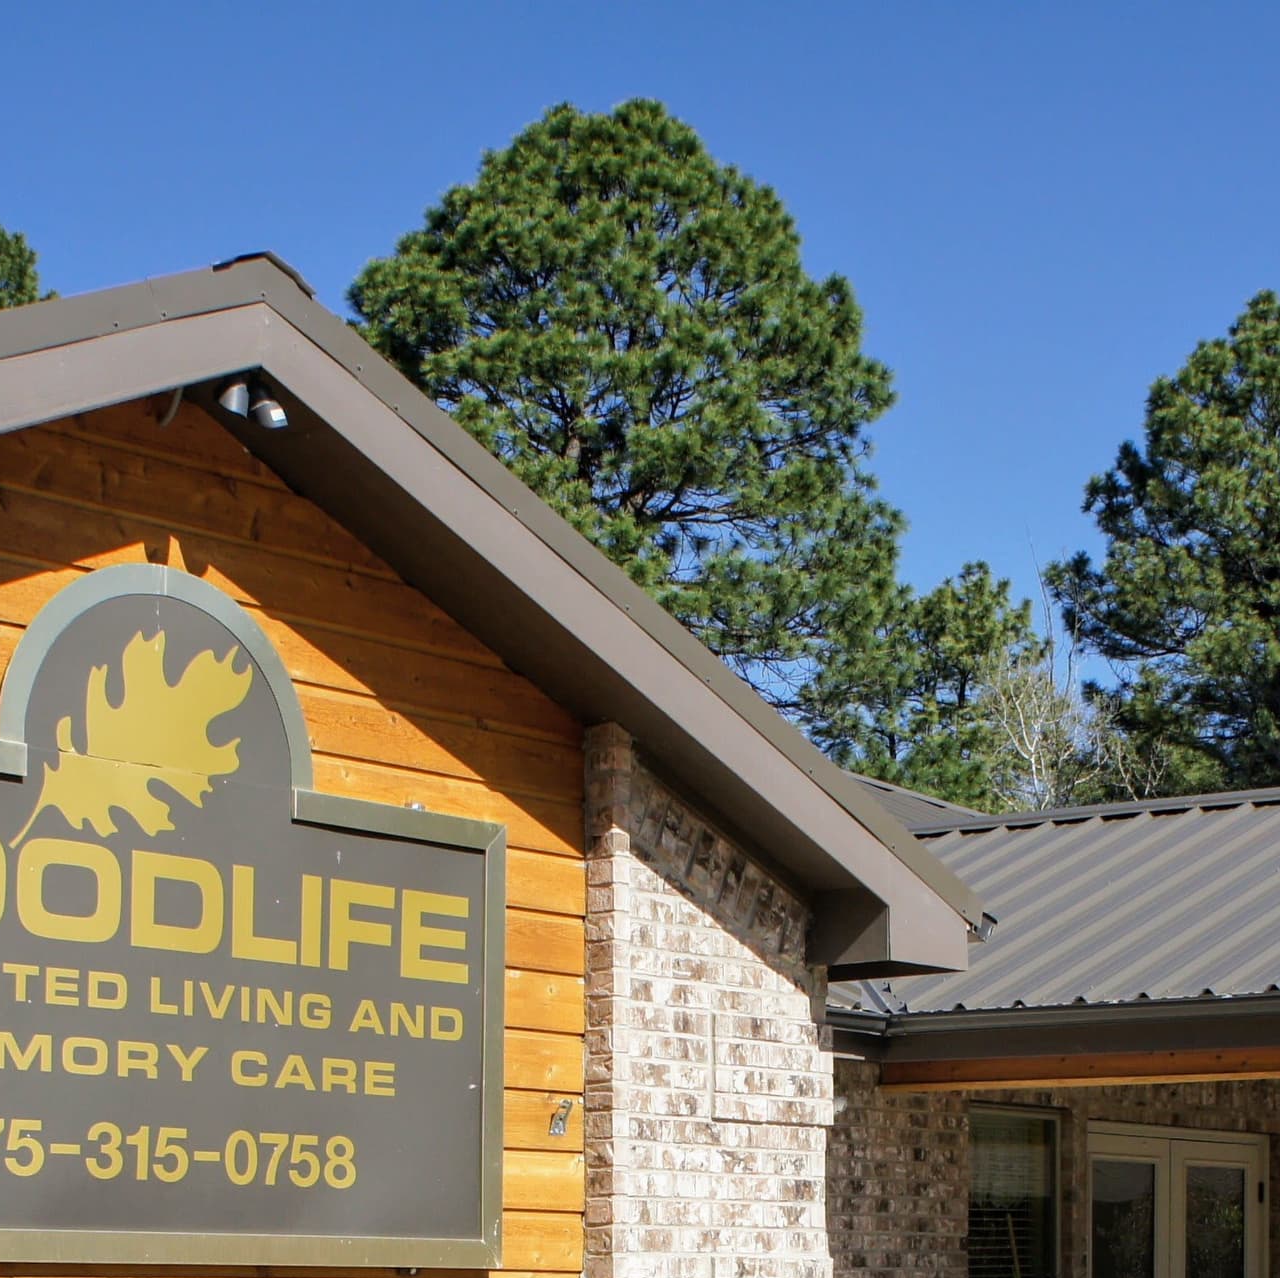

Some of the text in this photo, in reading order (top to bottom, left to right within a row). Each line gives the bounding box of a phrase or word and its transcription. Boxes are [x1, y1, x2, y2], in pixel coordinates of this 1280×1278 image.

[149, 978, 334, 1030] LIVING
[349, 998, 465, 1041] AND
[231, 1049, 398, 1098] CARE
